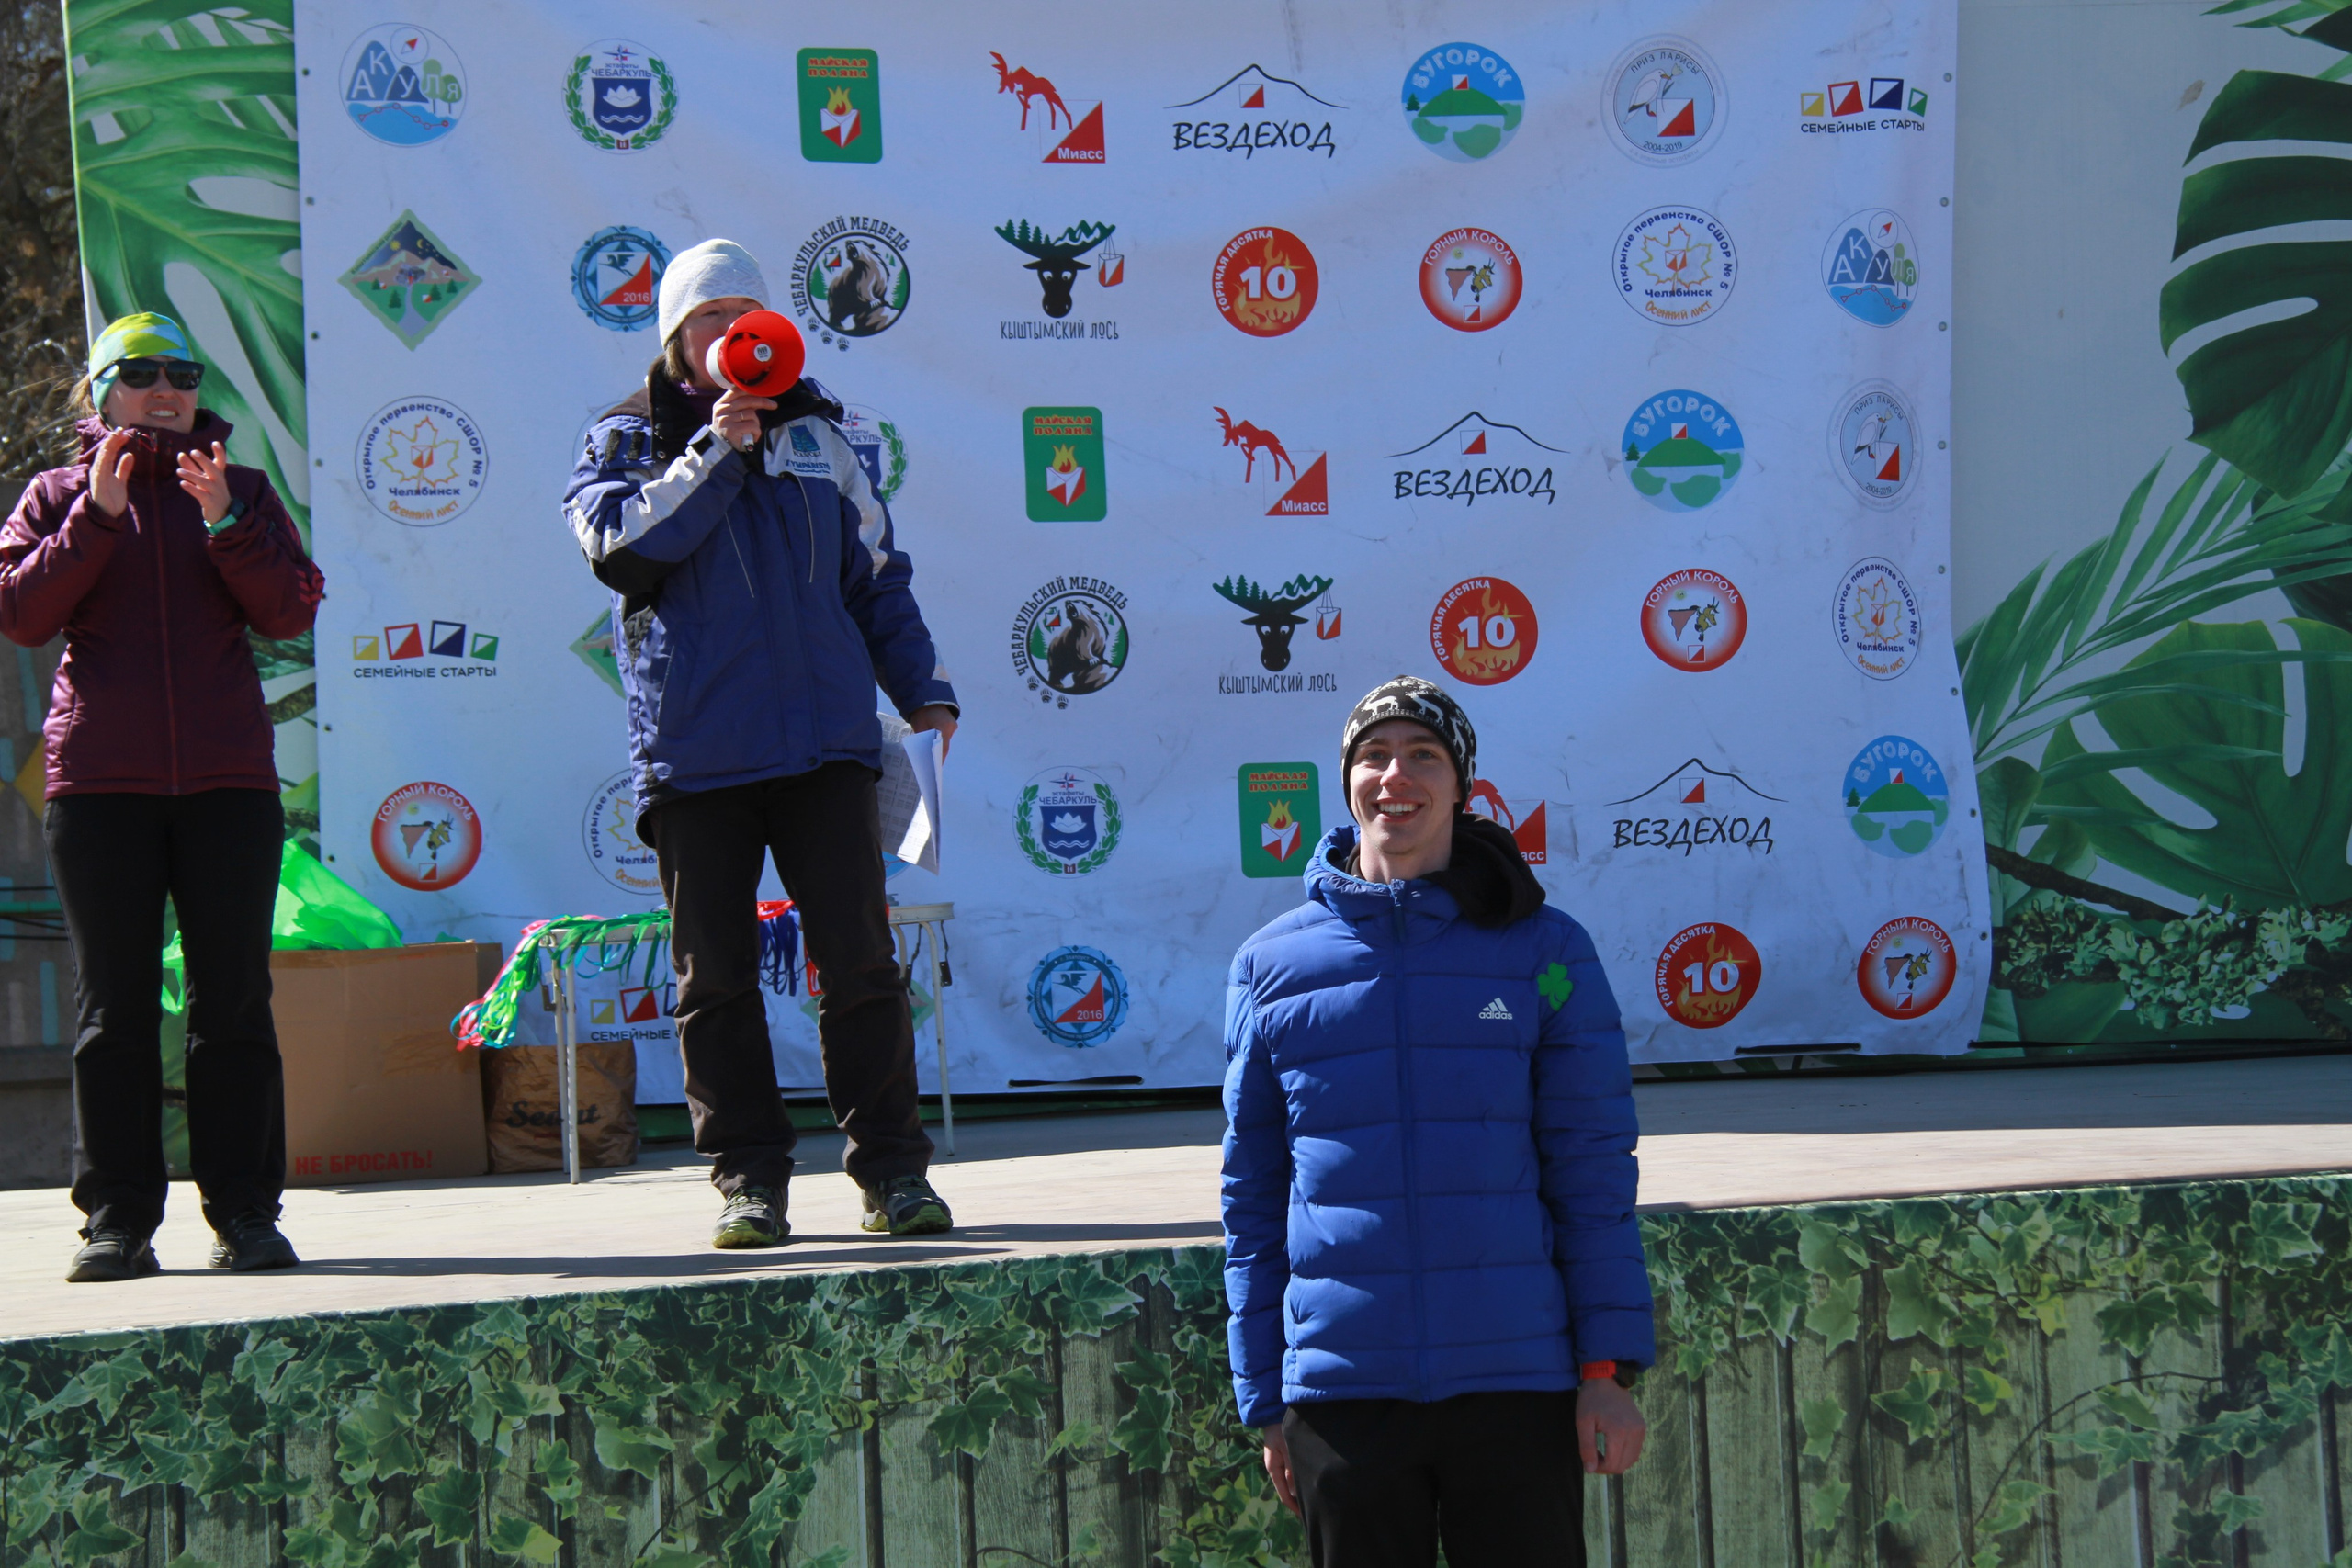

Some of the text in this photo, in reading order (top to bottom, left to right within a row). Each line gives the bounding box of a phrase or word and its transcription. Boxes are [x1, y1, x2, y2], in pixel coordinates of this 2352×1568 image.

[808, 56, 868, 67] МАЙСКАЯ
[1411, 49, 1512, 88] БУГОРОК
[1630, 51, 1700, 74] ПРИЗ ПАРИСЫ
[591, 69, 652, 77] ЧЕБАРКУЛЬ
[808, 68, 868, 78] ПОЛЯНА
[1800, 119, 1925, 133] СЕМЕЙНЫЕ СТАРТЫ
[1172, 120, 1335, 159] ВЕЗДЕХОД
[1057, 147, 1103, 160] Миасс
[1424, 228, 1515, 265] ГОРНЫЙ КОРОЛЬ
[1620, 211, 1733, 293] Открытое первенство СШОР № 5
[790, 215, 910, 317] ЧЕБАРКУЛЬСКИЙ МЕДВЕДЬ
[1215, 230, 1273, 312] ГОРЯЧАЯ ДЕСЯТКА
[1239, 265, 1297, 299] 10
[1645, 288, 1713, 298] Челябинск
[623, 292, 650, 302] 2016
[1645, 299, 1688, 321] Осенний
[1631, 396, 1731, 437] БУГОРОК
[1854, 397, 1873, 415] ПРИЗ
[1876, 395, 1904, 421] ПАРИСЫ
[1034, 414, 1092, 425] МАЙСКАЯ
[1034, 426, 1092, 435] ПОЛЯНА
[363, 425, 380, 490] Открытое
[379, 402, 454, 426] первенство
[456, 416, 481, 456] СШОР
[469, 479, 479, 489] 5
[849, 434, 882, 443] РКУЛЬ
[388, 486, 461, 497] Челябинск
[1394, 466, 1555, 507] ВЕЗДЕХОД
[1865, 482, 1892, 496] 2004-2019
[387, 499, 434, 520] Осенний
[1281, 499, 1327, 513] Миасс
[1645, 570, 1739, 608] ГОРНЫЙ КОРОЛЬ
[1838, 583, 1851, 644] Открытое
[1850, 563, 1896, 583] первенство
[1897, 580, 1916, 615] СШОР
[1908, 638, 1916, 647] 5
[1011, 575, 1129, 676] ЧЕБАРКУЛЬСКИЙ МЕДВЕДЬ
[1432, 579, 1491, 662] ГОРЯЧАЯ ДЕСЯТКА
[1457, 615, 1516, 648] 10
[1857, 642, 1905, 652] Челябинск
[353, 665, 496, 678] СЕМЕЙНЫЕ СТАРТЫ
[1857, 654, 1889, 674] Осенний
[1852, 741, 1937, 783] БУГОРОК
[1249, 771, 1308, 781] МАЙСКАЯ
[1249, 781, 1308, 792] ПОЛЯНА
[377, 782, 474, 822] ГОРНЫЙ КОРОЛЬ
[1038, 795, 1097, 805] ЧЕБАРКУЛЬ
[590, 795, 607, 859] Открытое
[1612, 814, 1773, 857] ВЕЗДЕХОД
[616, 855, 657, 864] Челяб
[1521, 851, 1544, 862] асс
[1866, 918, 1951, 955] ГОРНЫЙ КОРОЛЬ
[1657, 925, 1716, 1007] ГОРЯЧАЯ ДЕСЯТКА
[1682, 960, 1740, 993] 10
[1076, 1010, 1102, 1021] 2016
[1478, 1010, 1513, 1020] adidas
[590, 1027, 671, 1041] СЕМЕЙНЫЕ
[295, 1149, 433, 1176] НЕ БРОСАТЬ!
